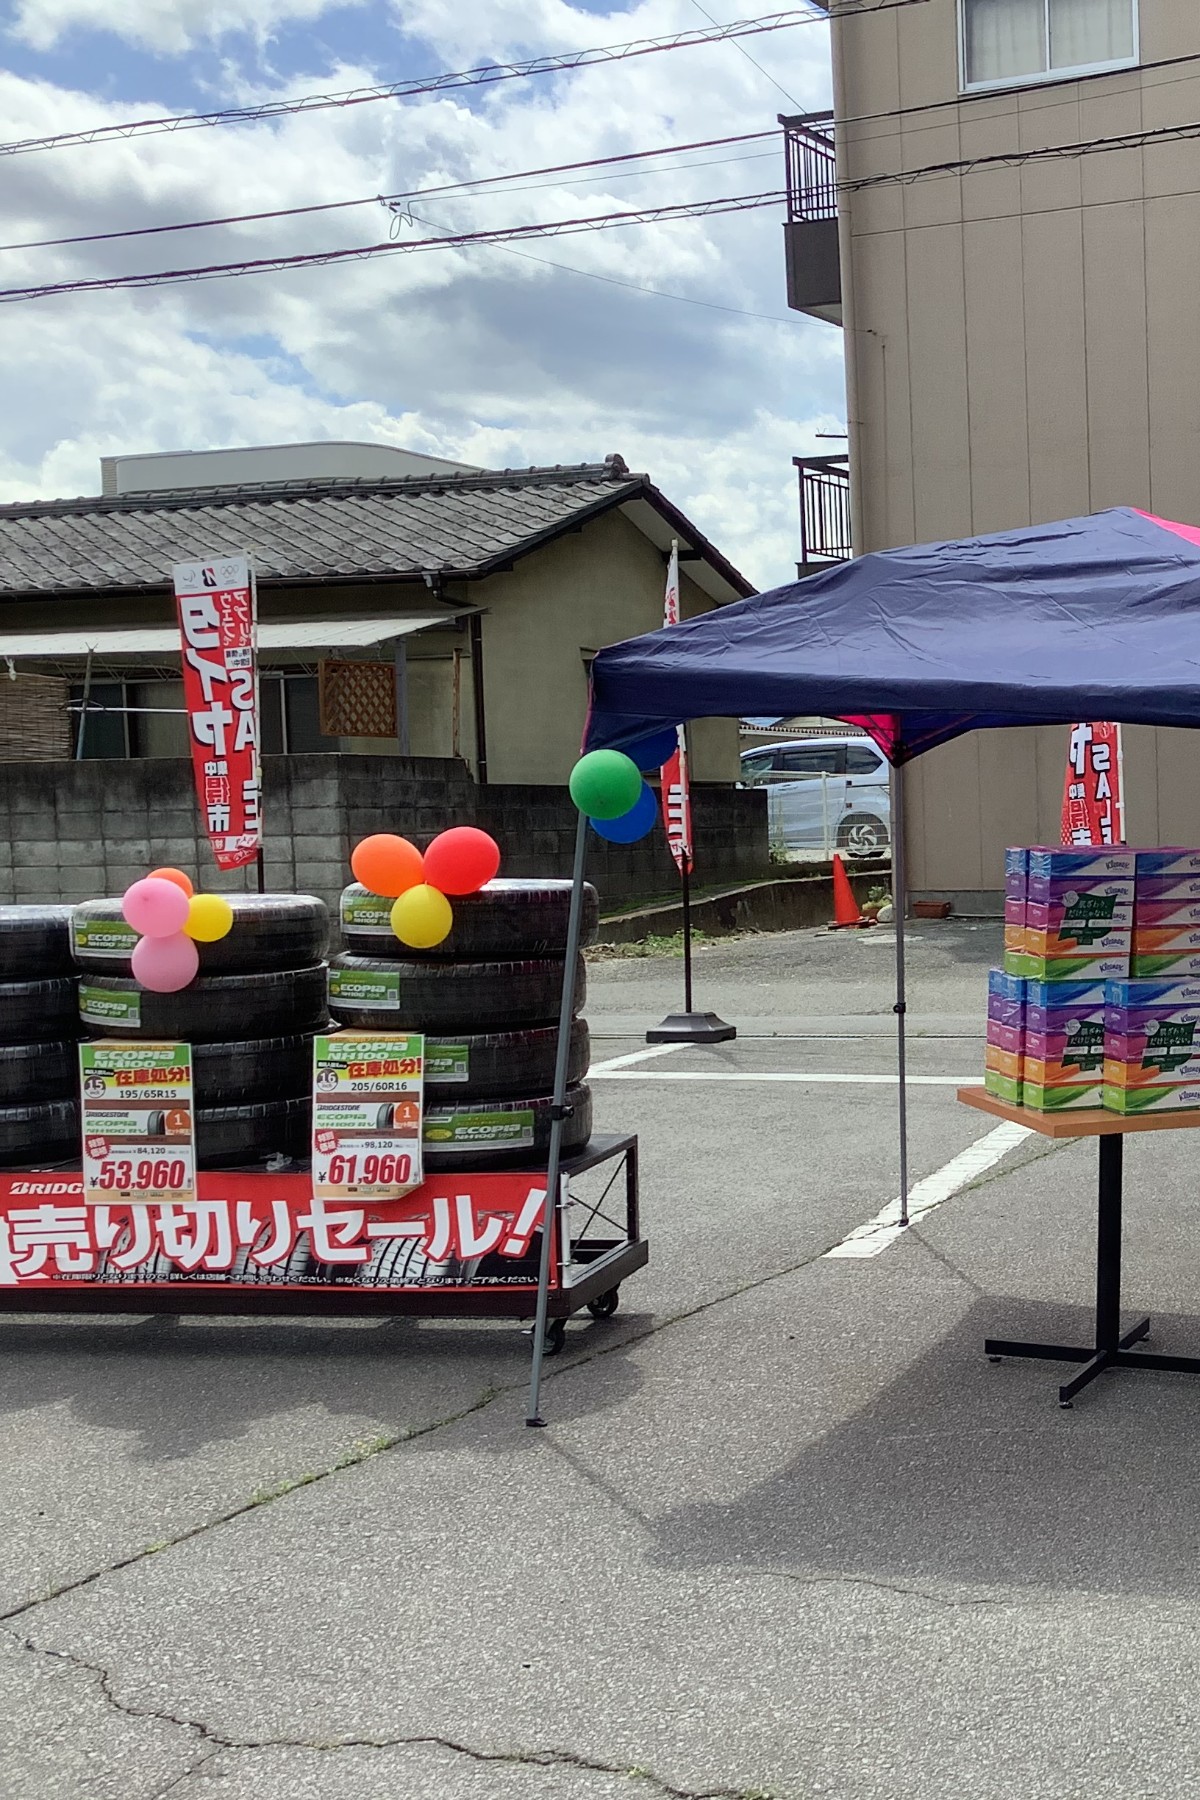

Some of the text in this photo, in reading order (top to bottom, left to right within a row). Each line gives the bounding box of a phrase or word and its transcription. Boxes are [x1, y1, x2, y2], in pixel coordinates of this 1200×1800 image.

[87, 934, 138, 942] ECOPIA
[340, 984, 386, 992] ECOPIA
[328, 1042, 408, 1052] ECOPIA
[94, 1050, 176, 1060] ECOPIA
[327, 1052, 390, 1060] NH100
[93, 1060, 156, 1068] NH100
[347, 1057, 422, 1079] 在庫処分!
[115, 1066, 190, 1086] 在庫処分!
[320, 1072, 336, 1082] 16
[88, 1079, 103, 1090] 15
[351, 1082, 407, 1091] 205/60R16
[119, 1089, 177, 1099] 195/65R15
[403, 1107, 411, 1118] 1
[174, 1113, 183, 1125] 1
[455, 1124, 520, 1135] ECOPIA
